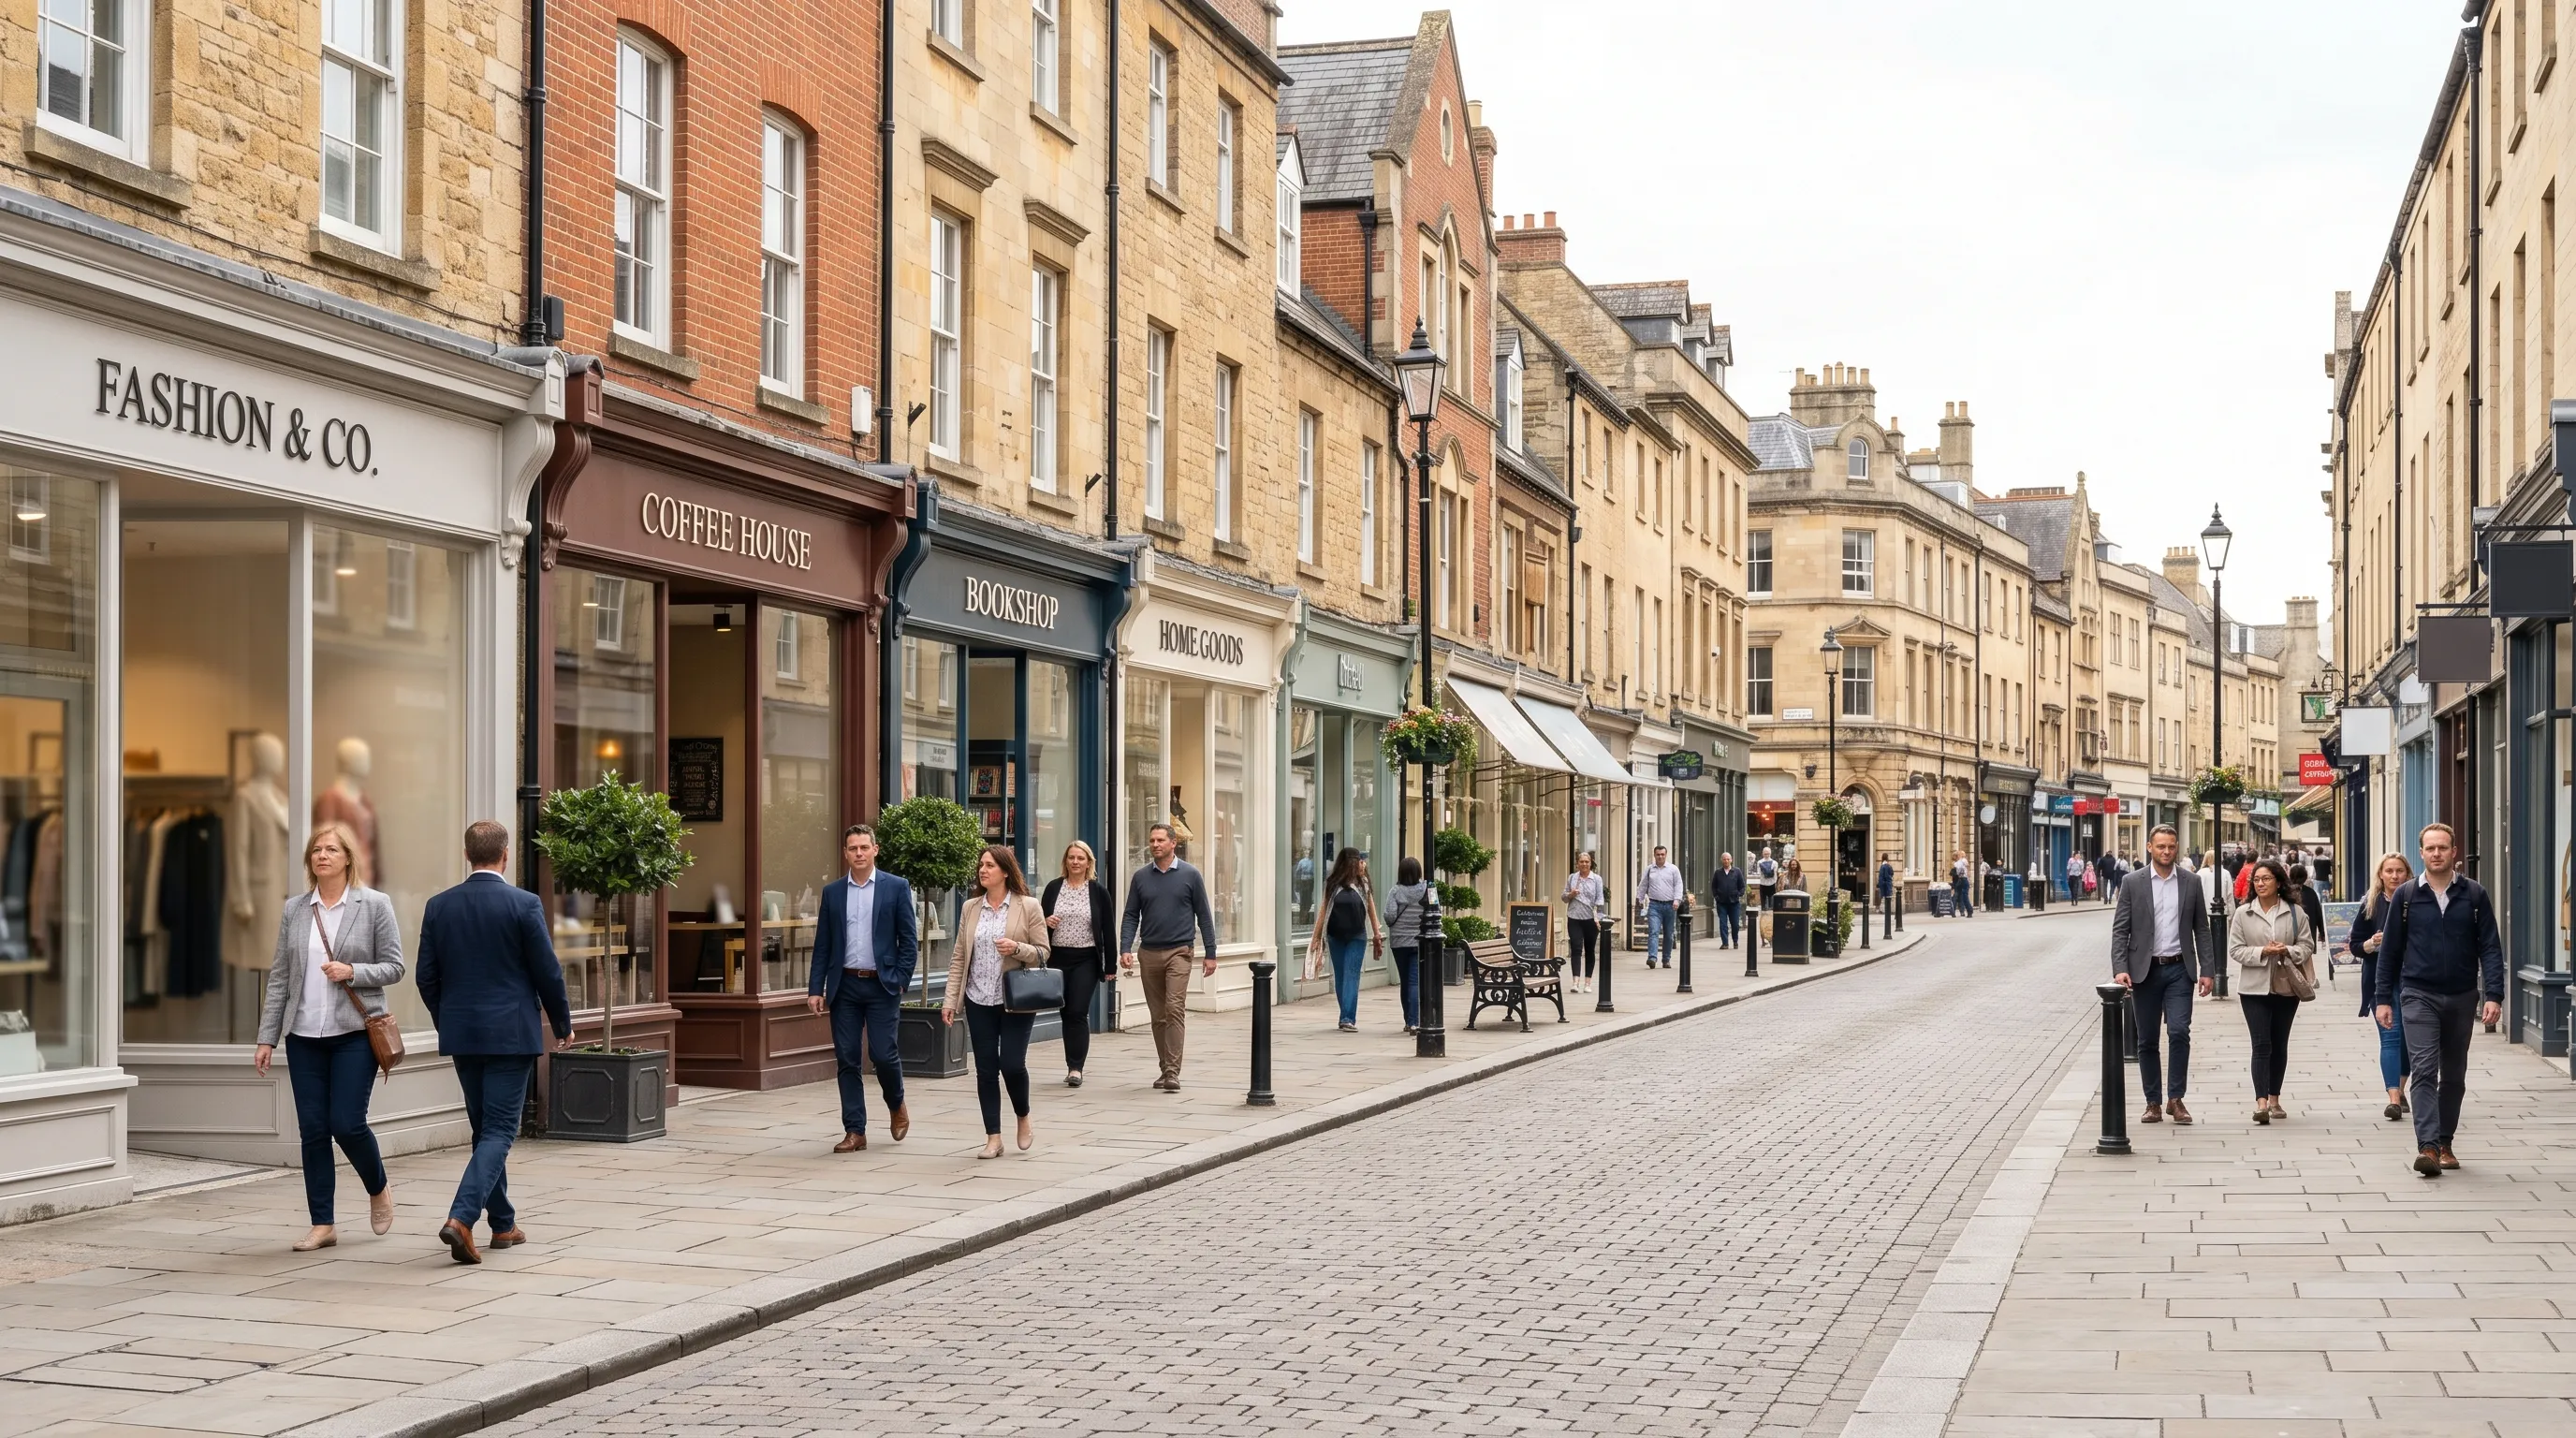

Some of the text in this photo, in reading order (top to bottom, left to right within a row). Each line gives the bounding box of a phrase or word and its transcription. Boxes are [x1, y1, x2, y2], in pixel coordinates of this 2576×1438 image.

[95, 358, 379, 477] FASHION & CO.
[641, 492, 812, 572] COFFEE HOUSE
[964, 576, 1060, 630] BOOKSHOP
[1159, 619, 1244, 666] HOME GOODS
